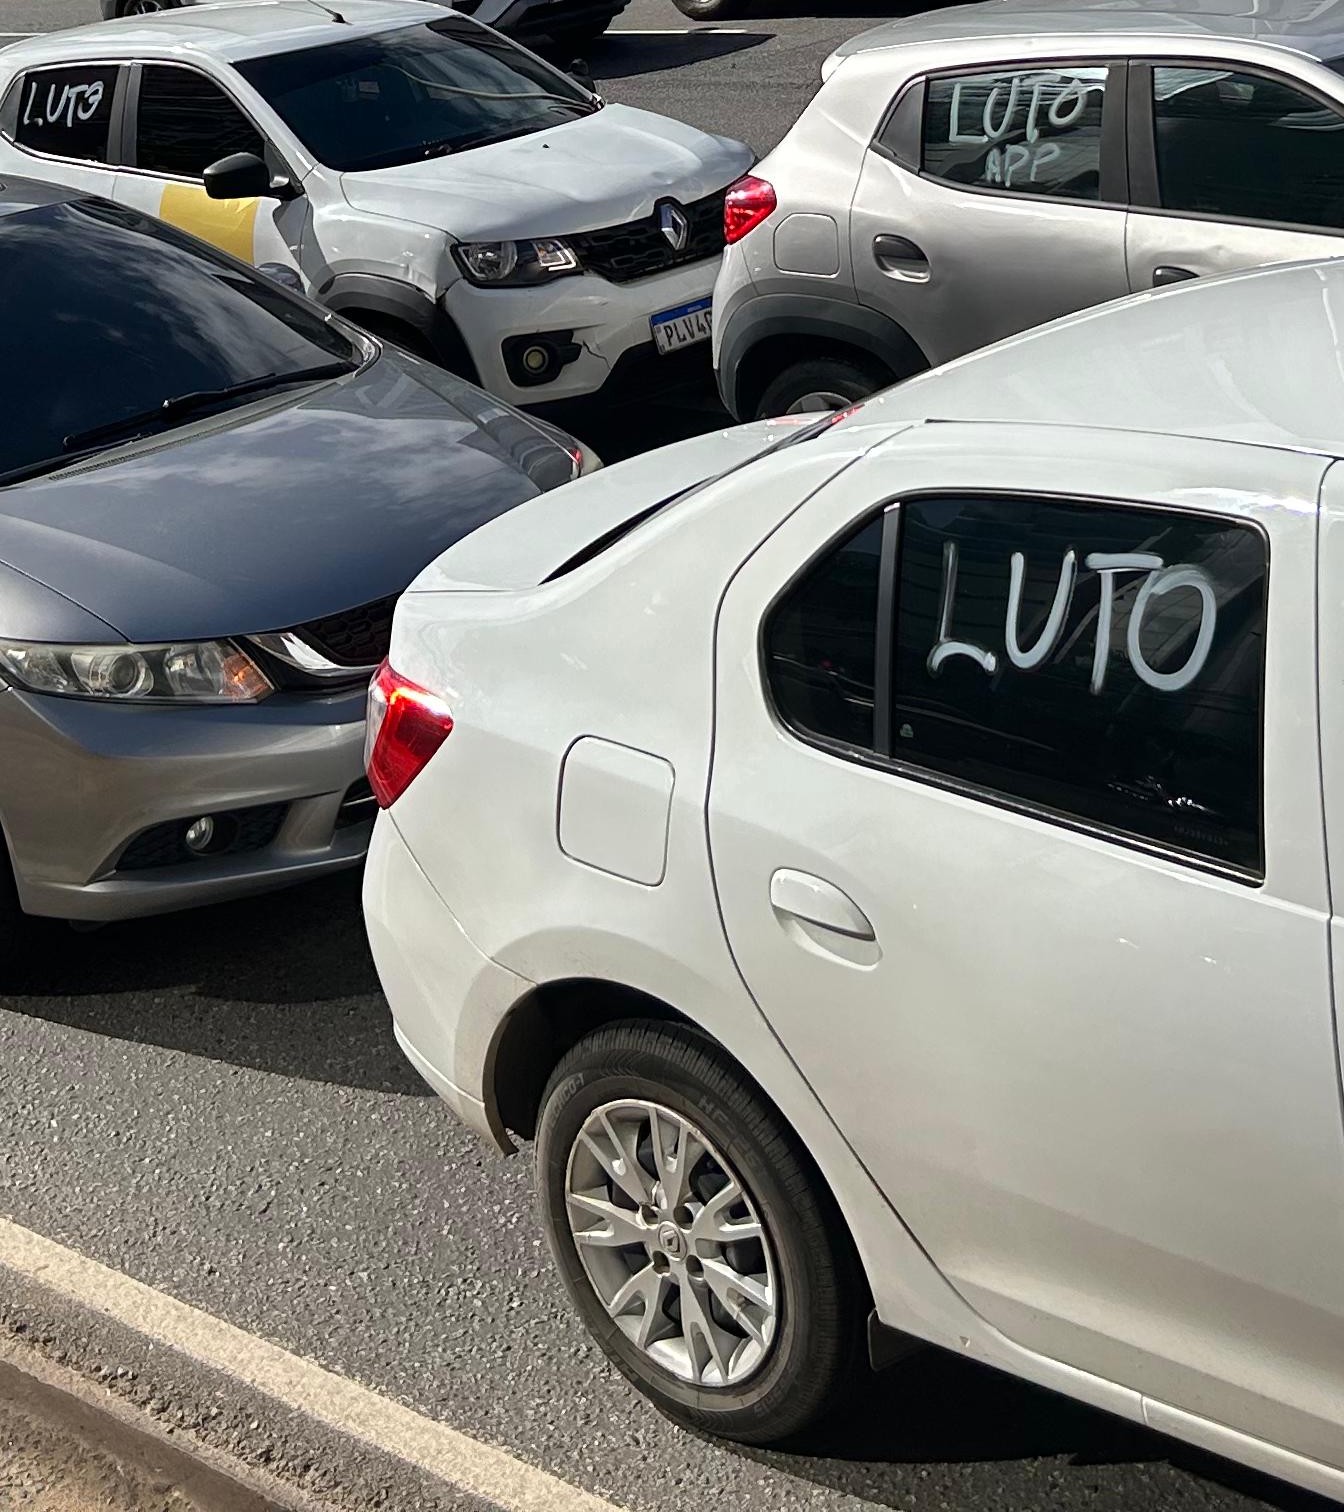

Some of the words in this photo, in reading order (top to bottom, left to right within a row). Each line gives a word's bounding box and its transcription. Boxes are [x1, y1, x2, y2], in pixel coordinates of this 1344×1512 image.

[23, 81, 104, 128] LUTO
[949, 77, 1087, 144] LUTO
[985, 143, 1061, 188] APP
[926, 541, 1218, 695] LUTO
